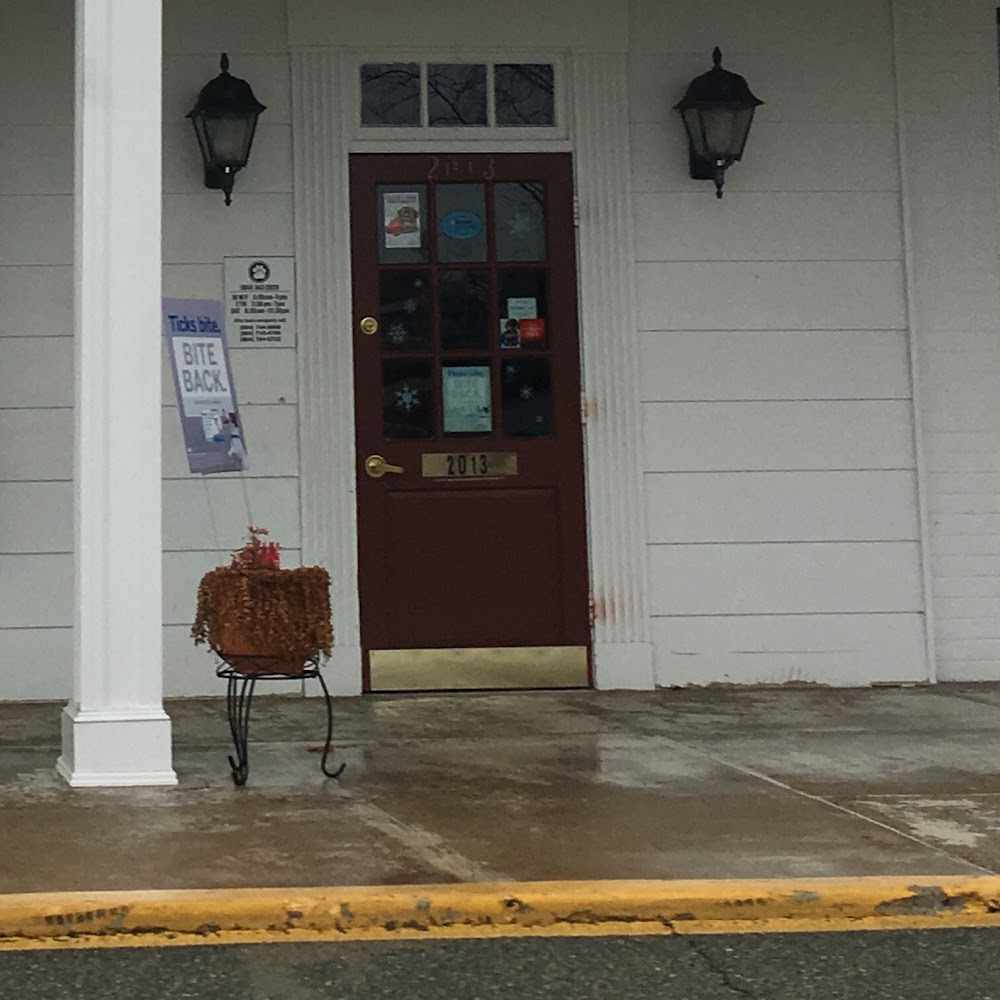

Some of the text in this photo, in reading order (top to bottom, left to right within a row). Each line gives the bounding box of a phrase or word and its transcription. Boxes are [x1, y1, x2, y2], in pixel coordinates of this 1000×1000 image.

[168, 315, 197, 333] Ticks
[182, 342, 218, 366] BITE
[446, 454, 489, 475] 2013
